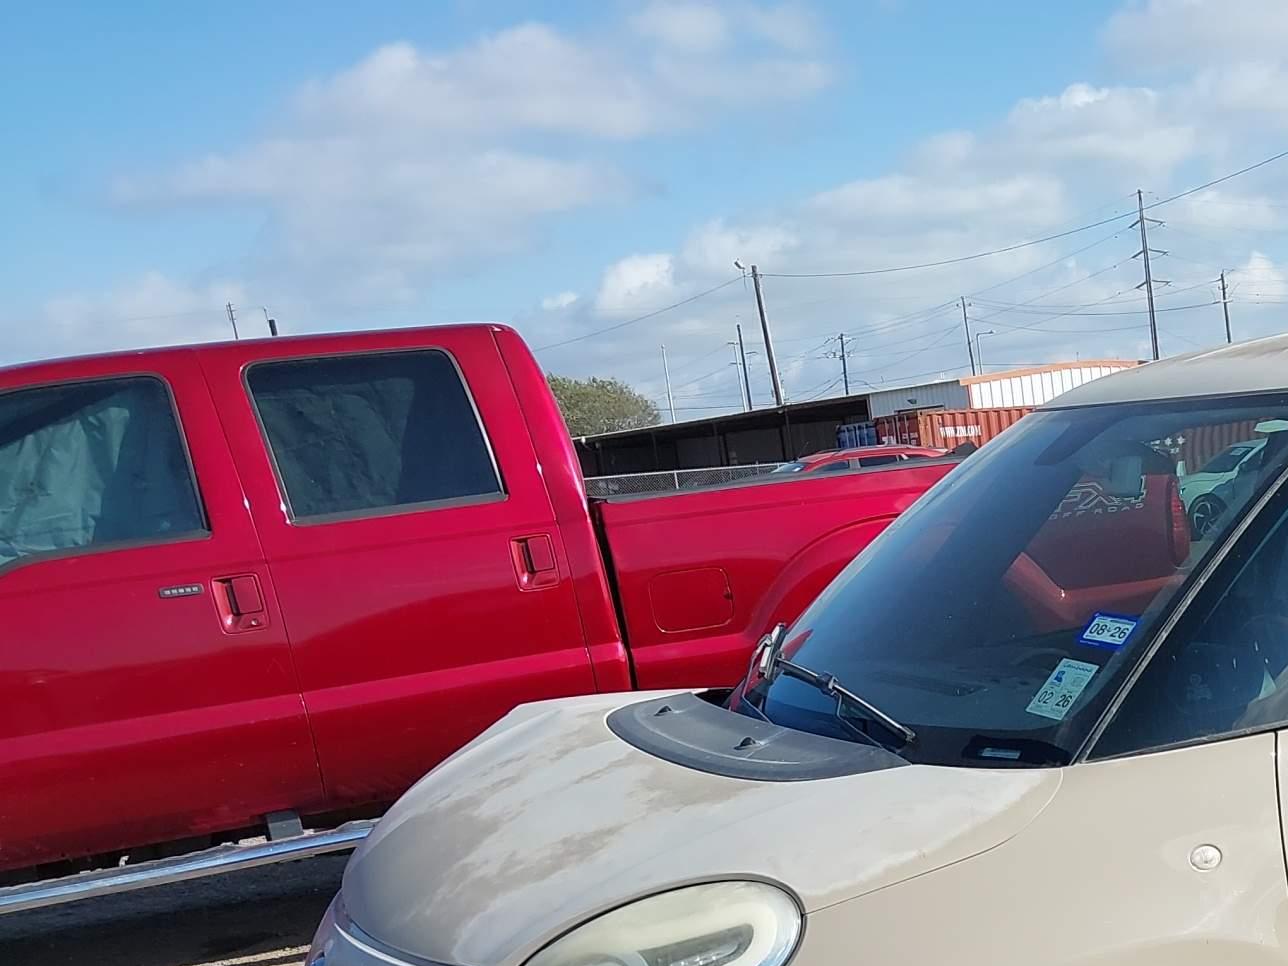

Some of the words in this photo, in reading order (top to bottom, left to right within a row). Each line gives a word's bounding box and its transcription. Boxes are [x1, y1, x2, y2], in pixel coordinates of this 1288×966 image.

[1094, 502, 1144, 515] ROAD
[1088, 622, 1108, 636] 08
[1110, 626, 1130, 640] 26
[1037, 690, 1054, 705] 02
[1055, 694, 1073, 708] 26
